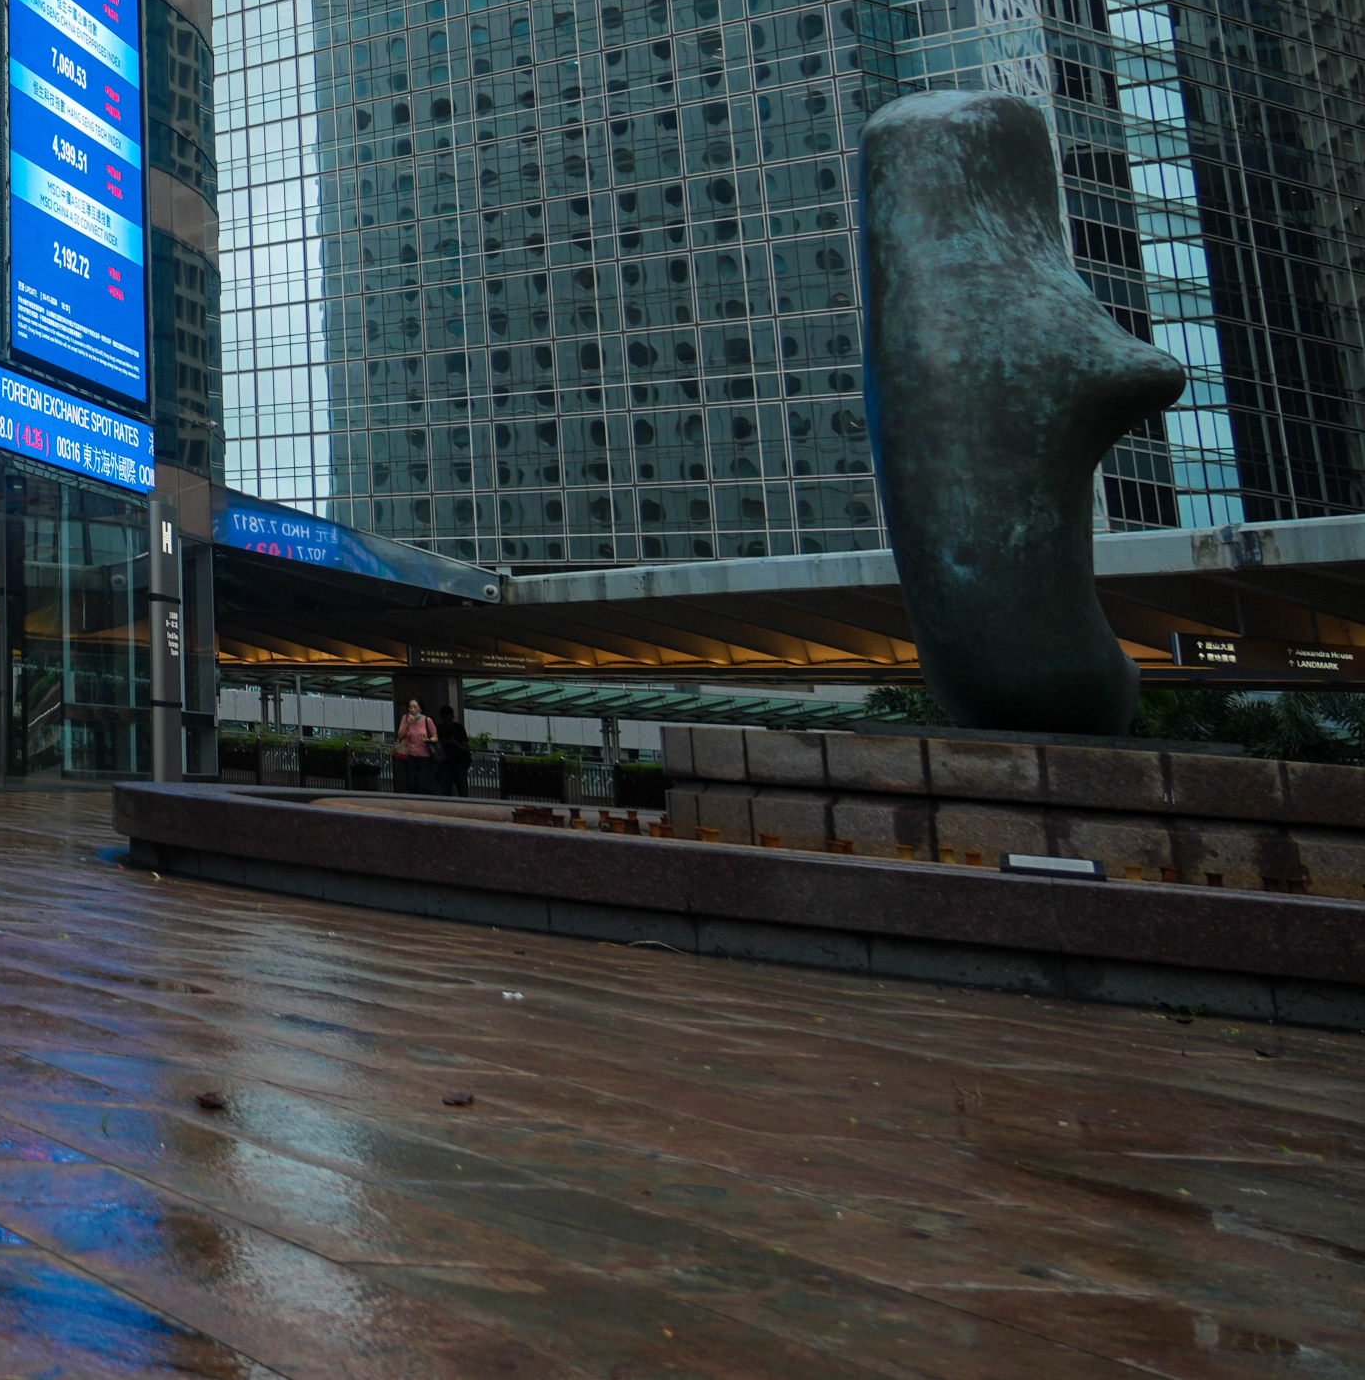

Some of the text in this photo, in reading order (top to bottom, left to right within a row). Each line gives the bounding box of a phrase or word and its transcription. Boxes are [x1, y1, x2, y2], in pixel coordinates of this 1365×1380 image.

[1, 377, 43, 412] FOREIGN
[43, 392, 91, 429] EXCHANGE
[91, 411, 114, 438] SPOT
[113, 419, 140, 449] RATES
[56, 435, 81, 464] 00316
[1296, 659, 1340, 670] LANDMARK
